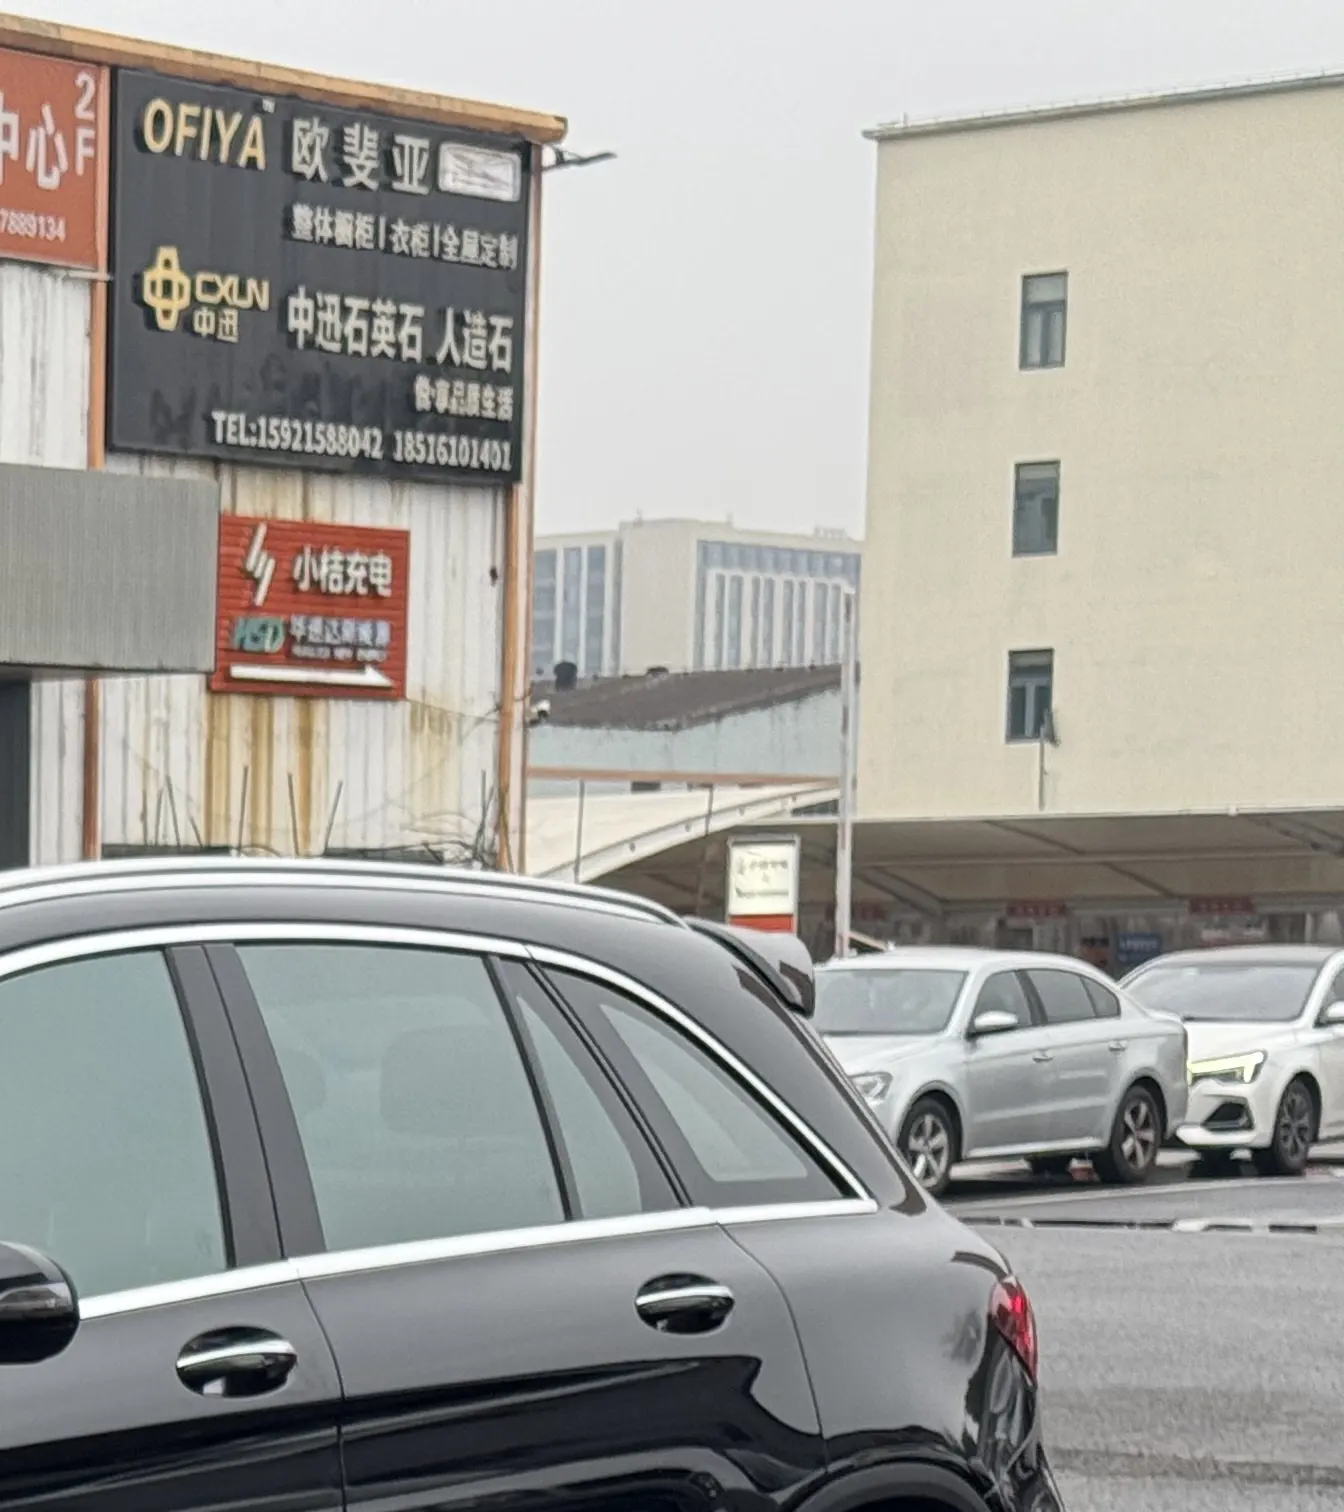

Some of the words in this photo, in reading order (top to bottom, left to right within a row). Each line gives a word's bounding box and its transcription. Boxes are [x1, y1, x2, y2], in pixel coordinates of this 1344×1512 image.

[74, 72, 97, 176] 2F
[142, 98, 267, 171] OFIYA
[435, 308, 513, 373] 人造石
[392, 430, 512, 472] 18516101401
